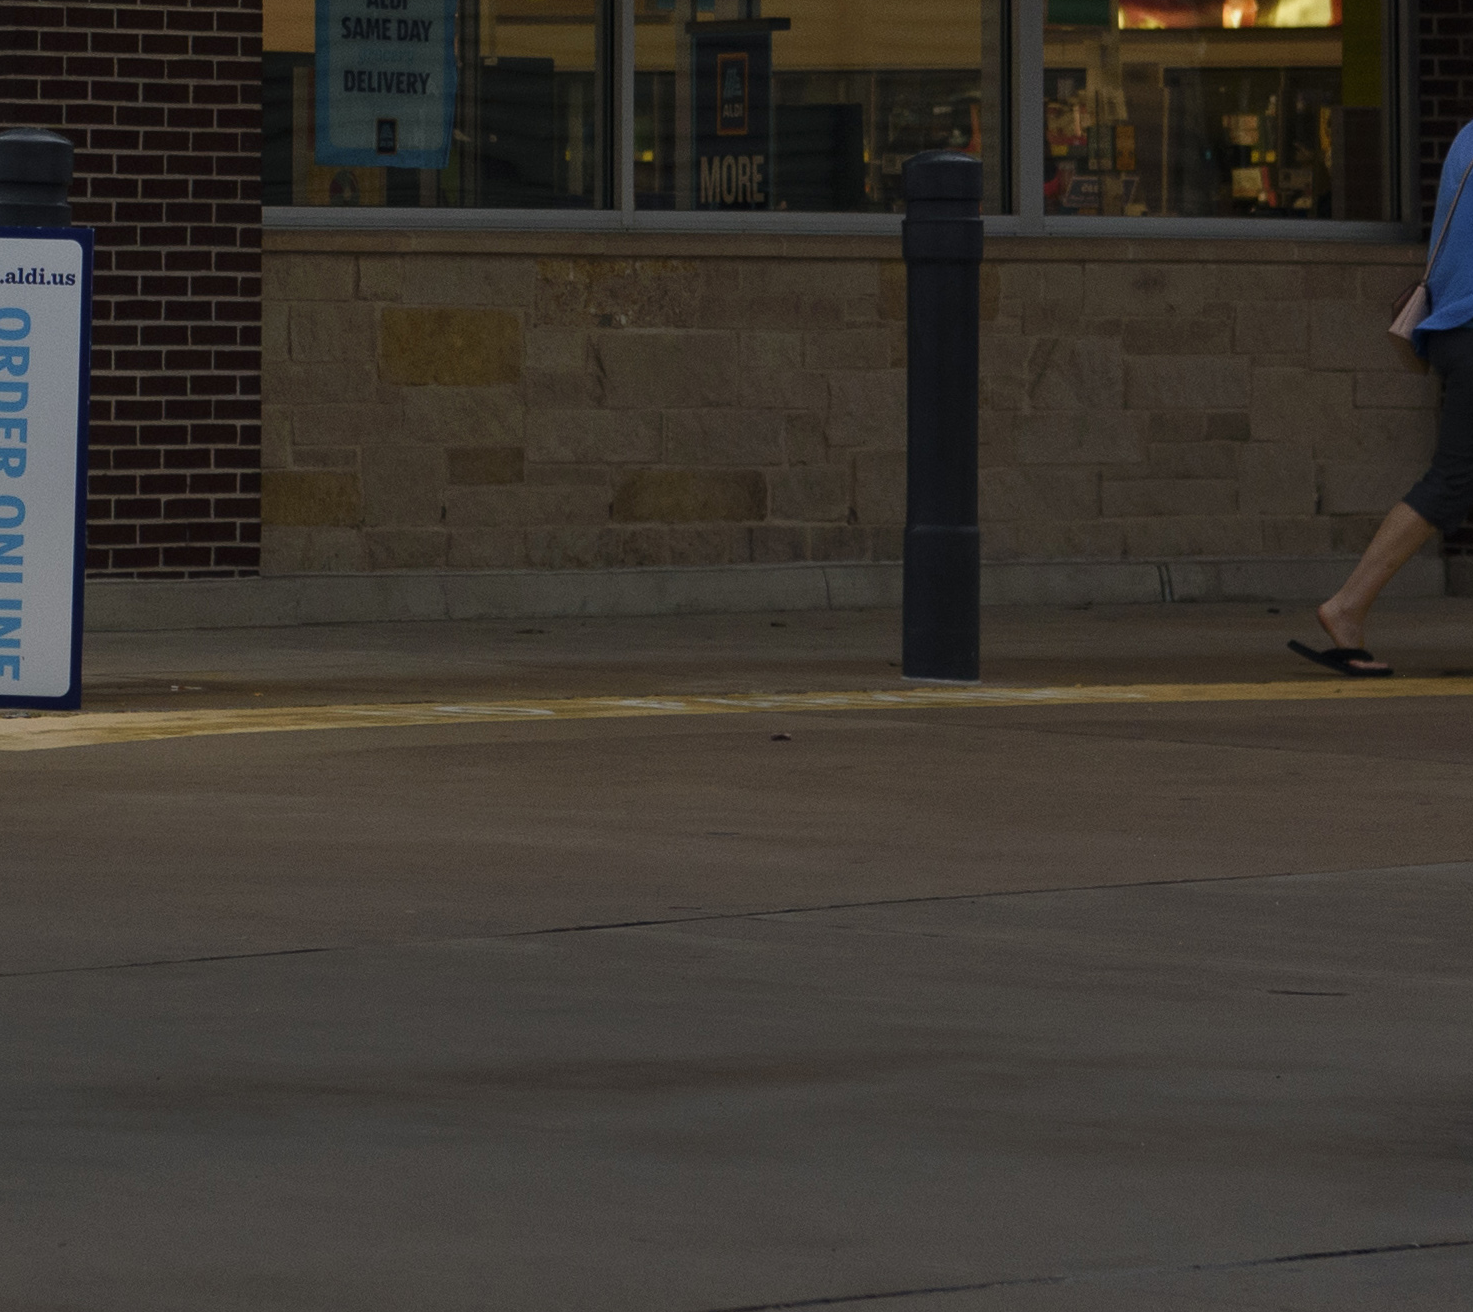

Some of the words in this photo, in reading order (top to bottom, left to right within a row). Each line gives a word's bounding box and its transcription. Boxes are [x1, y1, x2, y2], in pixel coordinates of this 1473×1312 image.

[341, 17, 391, 41] SAME
[397, 19, 433, 42] DAY
[344, 69, 430, 95] DELIVERY
[722, 103, 743, 118] ALDI
[700, 155, 766, 205] MORE
